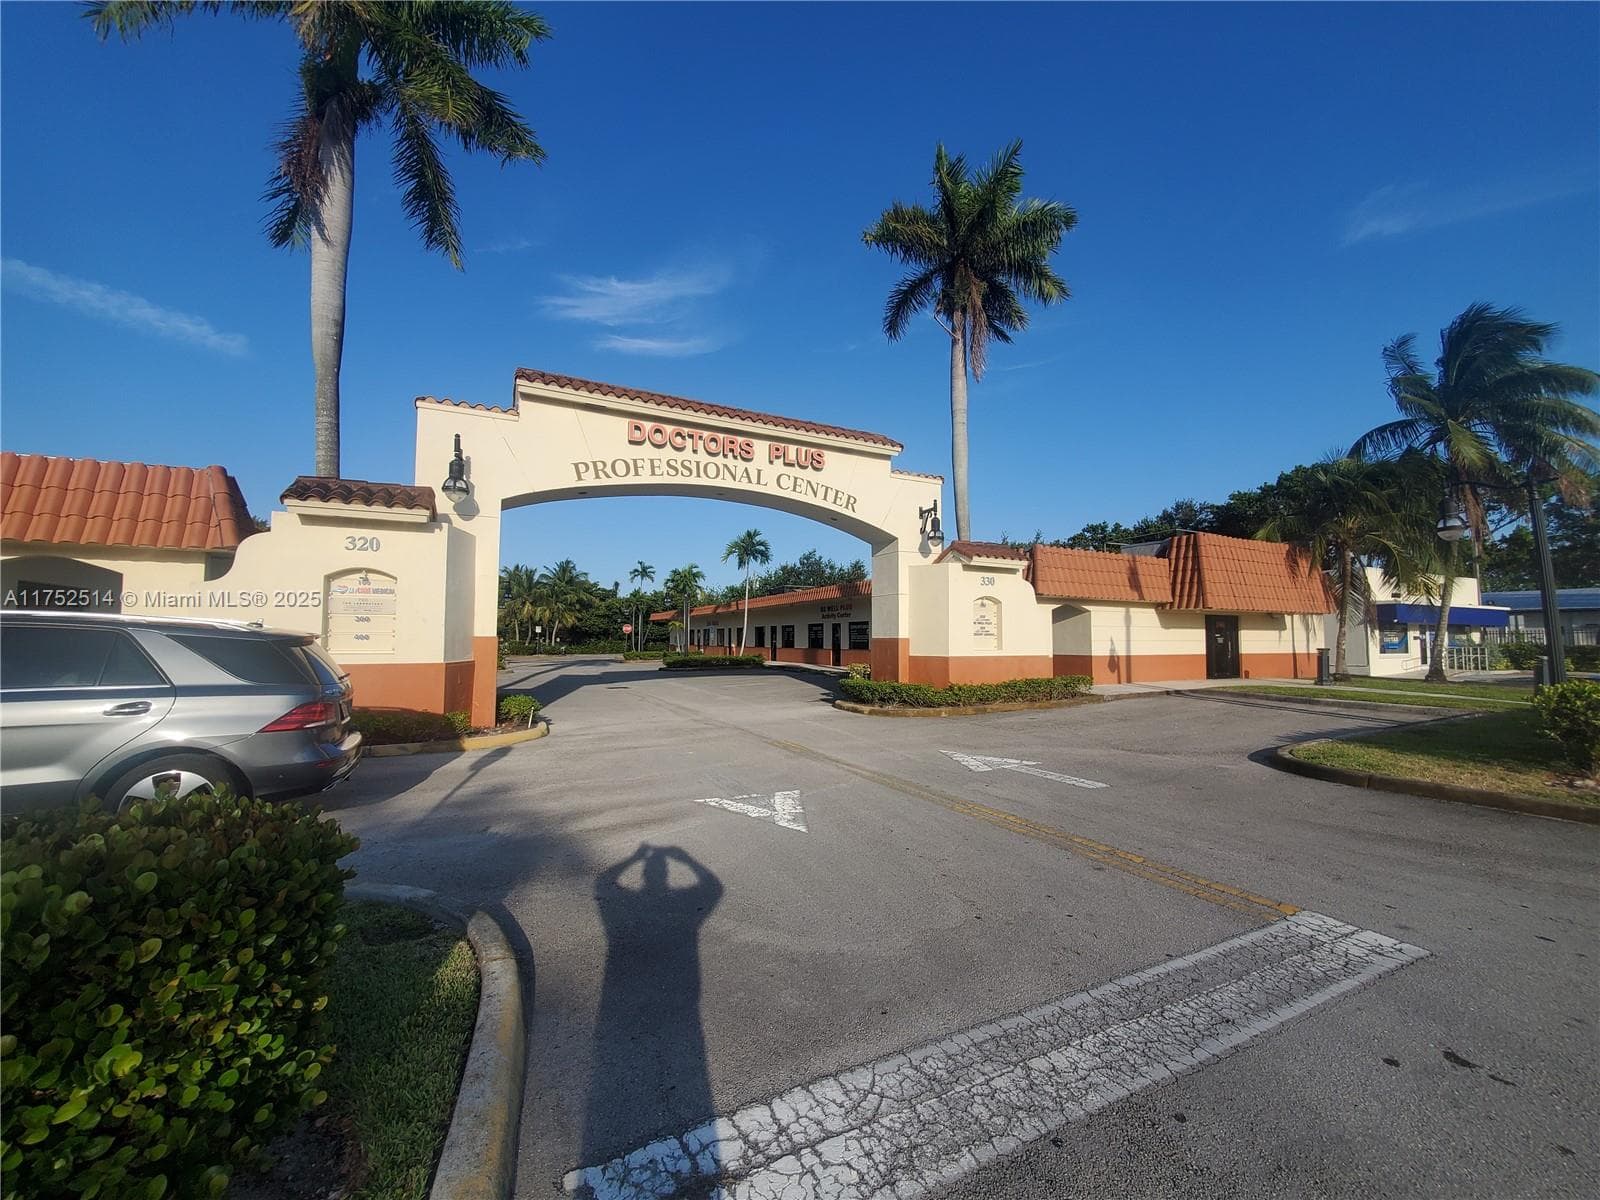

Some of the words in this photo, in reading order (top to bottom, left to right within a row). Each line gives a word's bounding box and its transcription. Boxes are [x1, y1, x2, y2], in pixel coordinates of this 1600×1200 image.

[627, 418, 755, 463] DOCTORS
[768, 442, 826, 472] PLUS
[570, 458, 769, 487] PROFESSIONAL
[776, 472, 858, 513] CENTER
[344, 535, 381, 552] 320
[980, 576, 995, 586] 330
